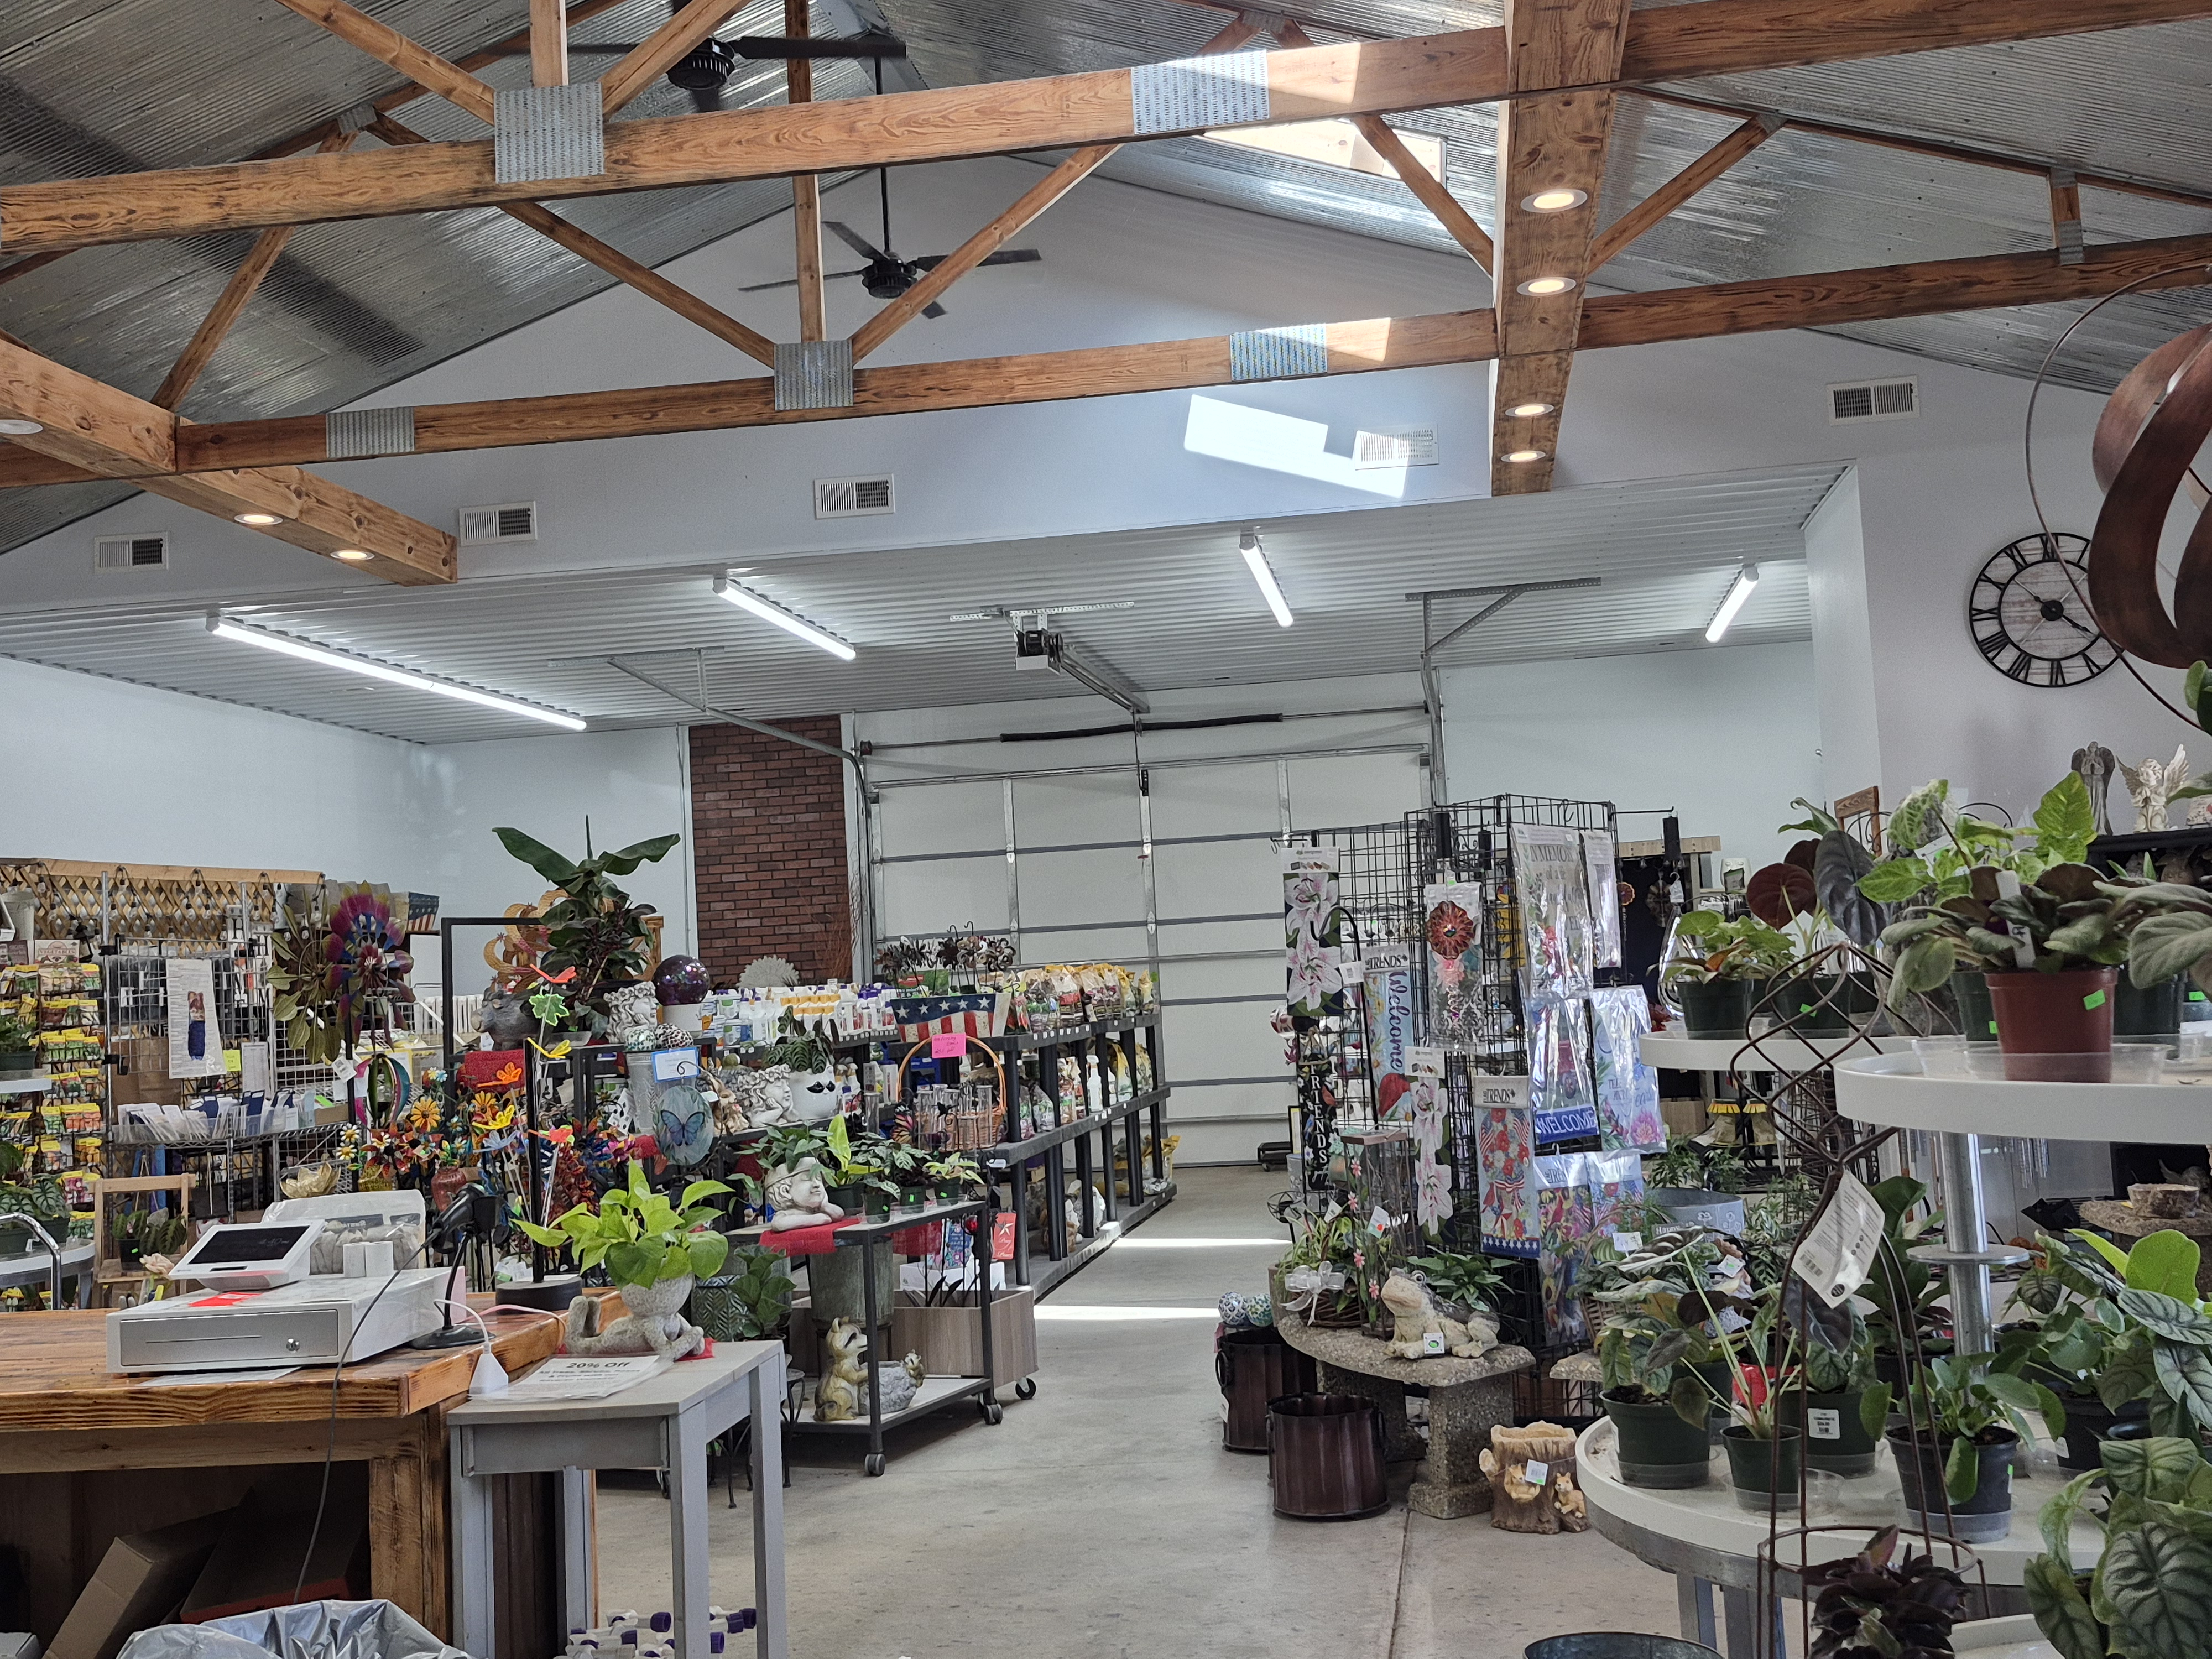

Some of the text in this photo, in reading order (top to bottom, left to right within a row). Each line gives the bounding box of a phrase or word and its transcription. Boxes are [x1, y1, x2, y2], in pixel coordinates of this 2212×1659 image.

[1369, 954, 1401, 969] TRENDS
[1389, 971, 1411, 1071] Welcome
[1486, 1088, 1510, 1103] TRENDS
[1536, 1111, 1597, 1135] WELCOME
